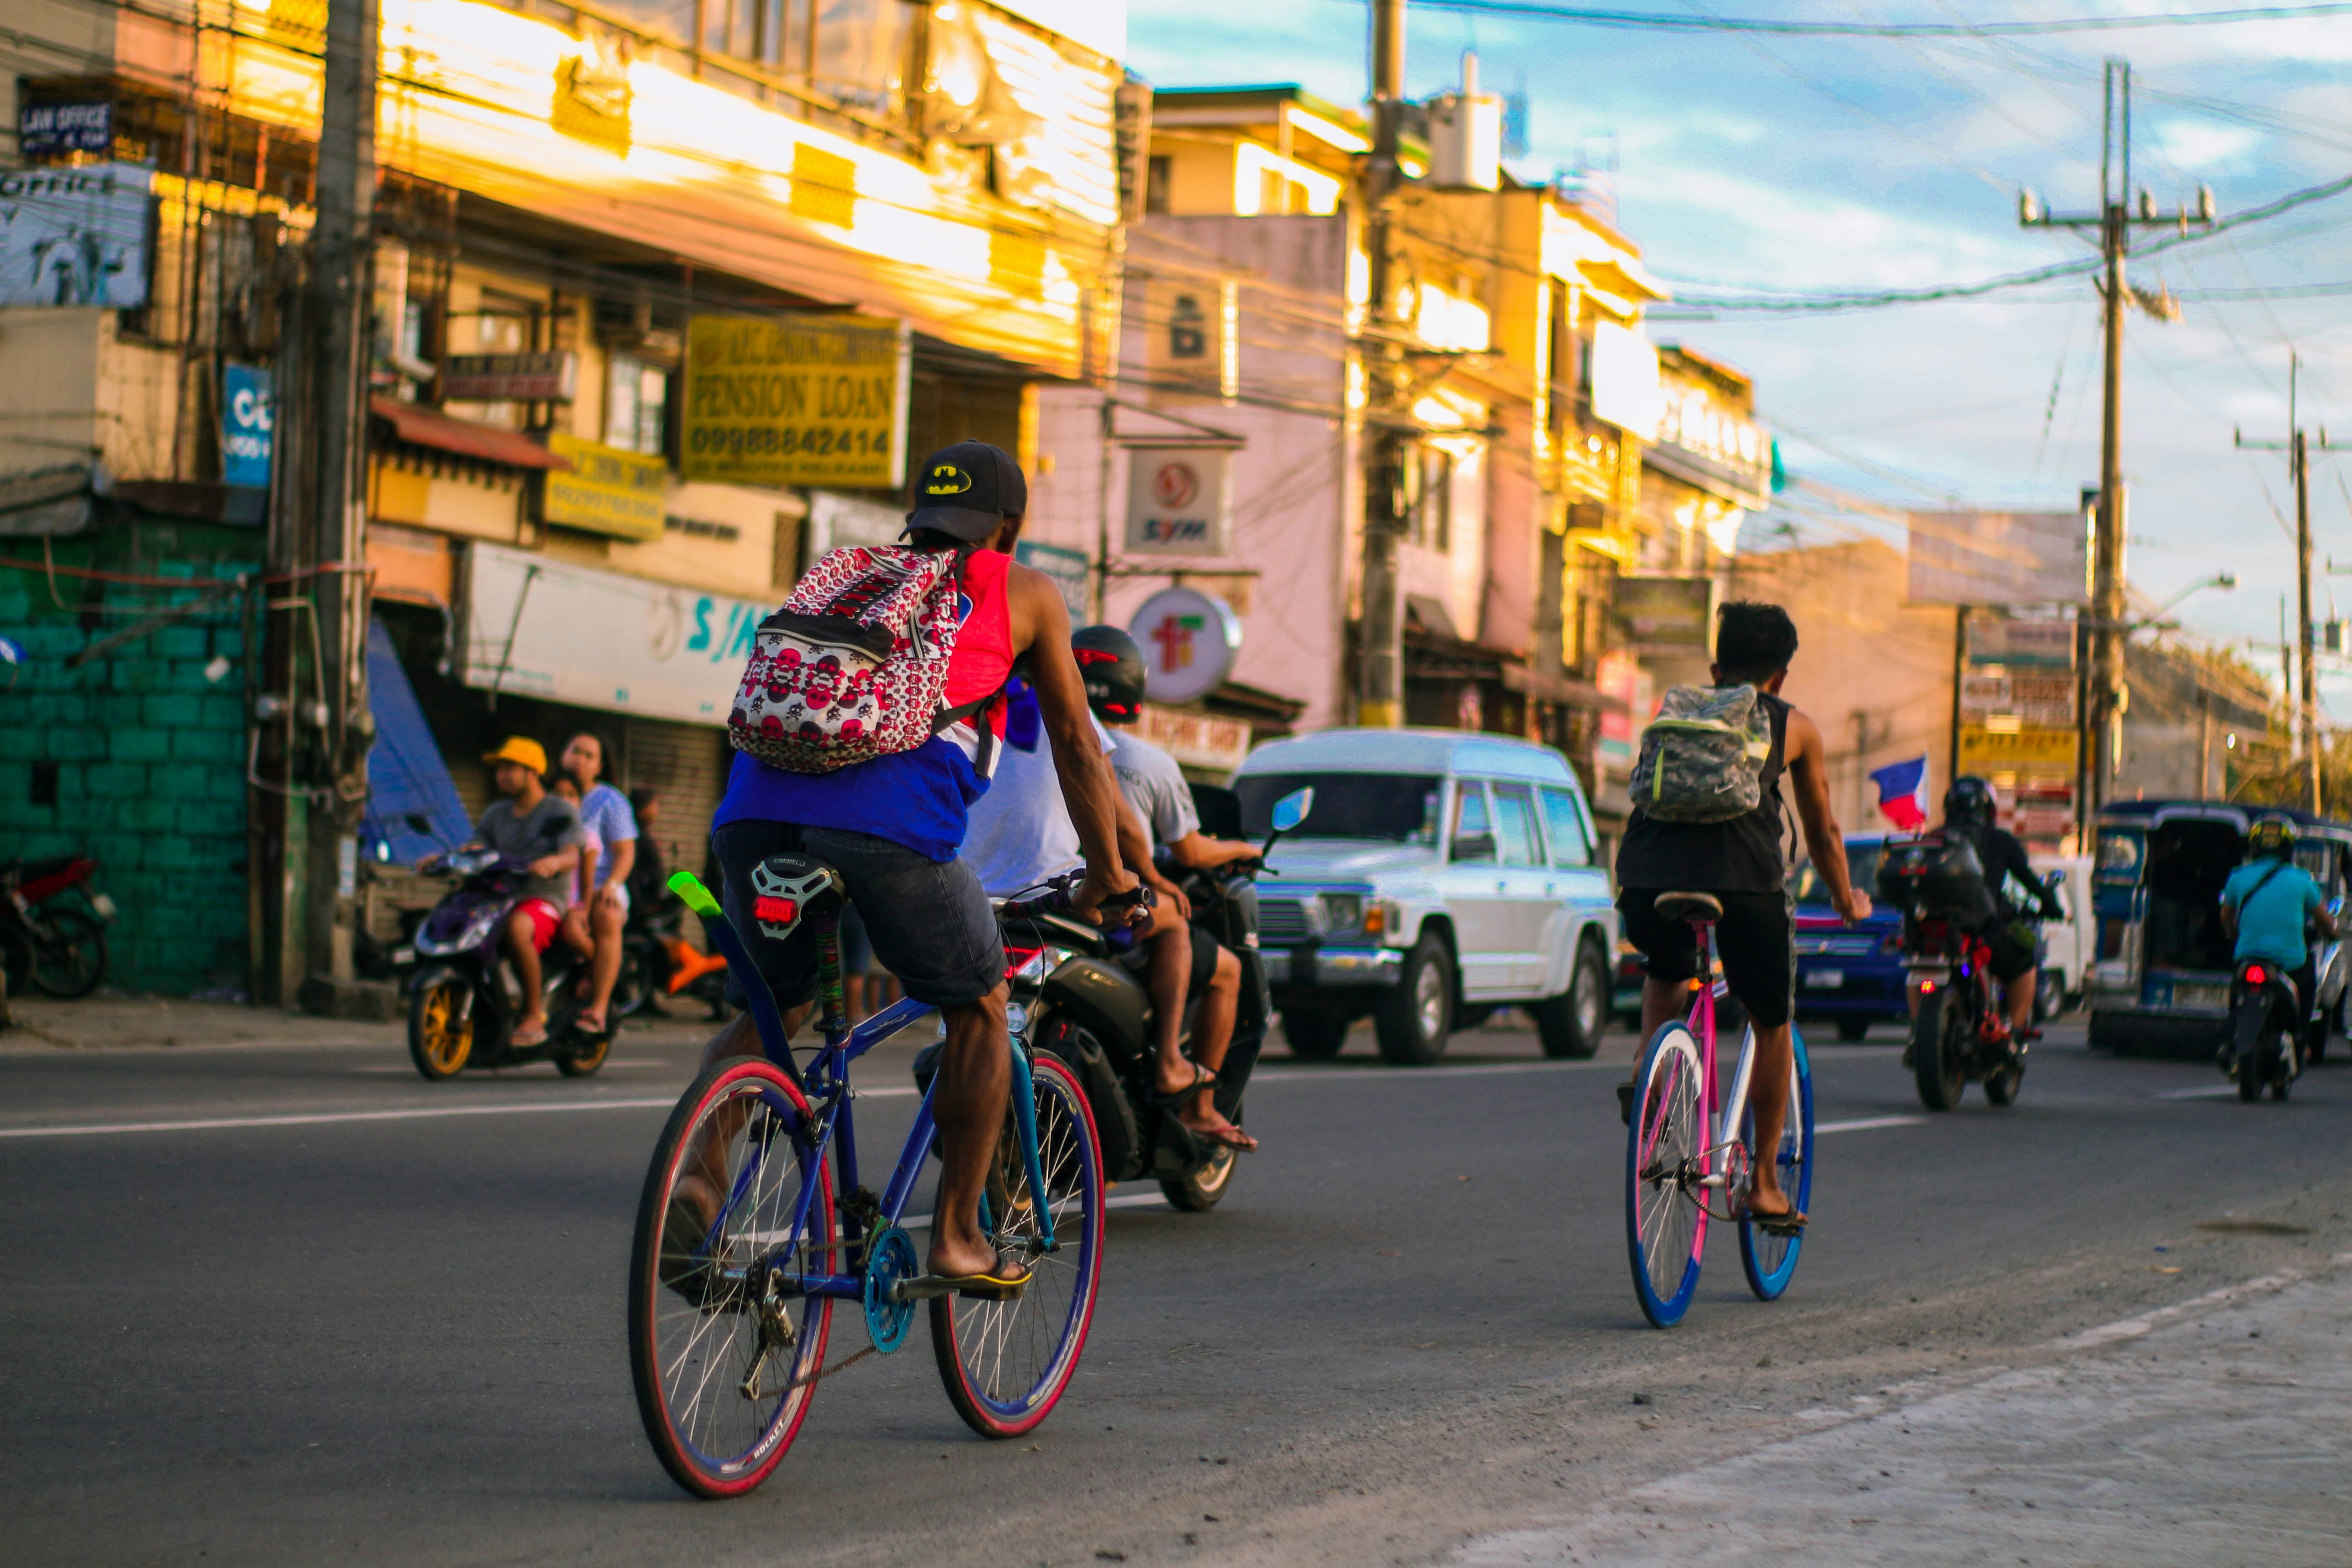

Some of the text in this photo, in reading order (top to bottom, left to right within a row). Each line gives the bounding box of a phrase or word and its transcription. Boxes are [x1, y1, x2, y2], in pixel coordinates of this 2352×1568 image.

[21, 103, 110, 133] LAW OFFICE
[691, 373, 894, 420] PENSION LOAN
[691, 426, 888, 456] 09988842414
[1141, 518, 1207, 544] SYM
[774, 858, 805, 867] CIMINELLI
[753, 1418, 784, 1455] ROCKET
